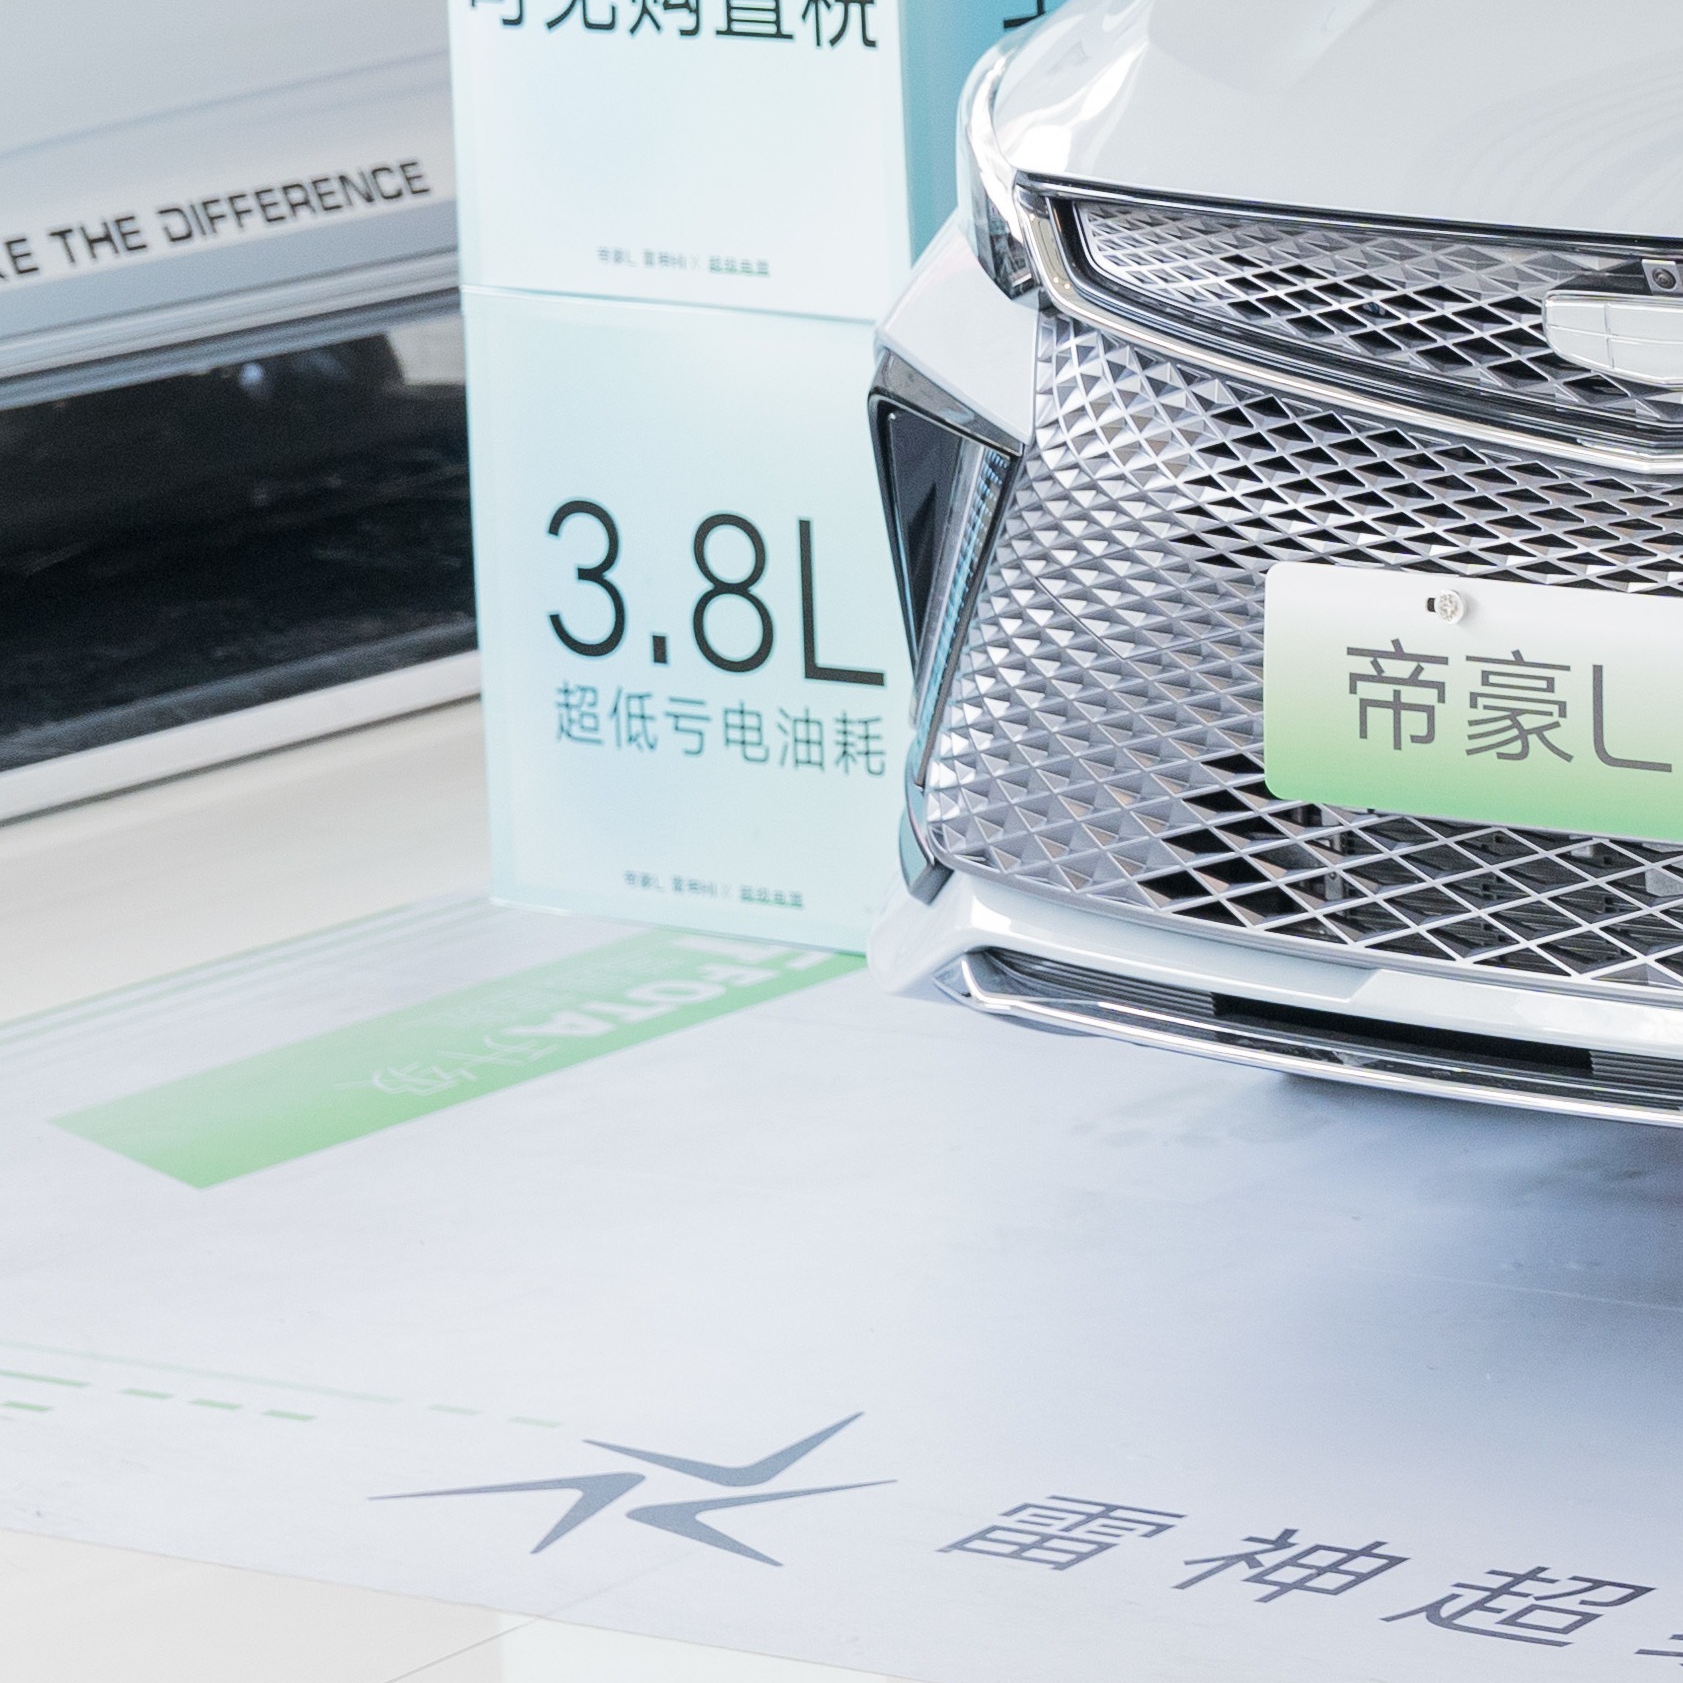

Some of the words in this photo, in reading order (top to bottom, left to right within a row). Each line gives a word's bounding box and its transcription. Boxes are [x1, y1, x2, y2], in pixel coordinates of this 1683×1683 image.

[50, 215, 148, 265] THE
[158, 160, 432, 244] DIFFERENCE
[547, 500, 886, 688] 3.8L
[555, 680, 887, 778] 超低亏电油耗
[1345, 637, 1674, 774] 帝豪L
